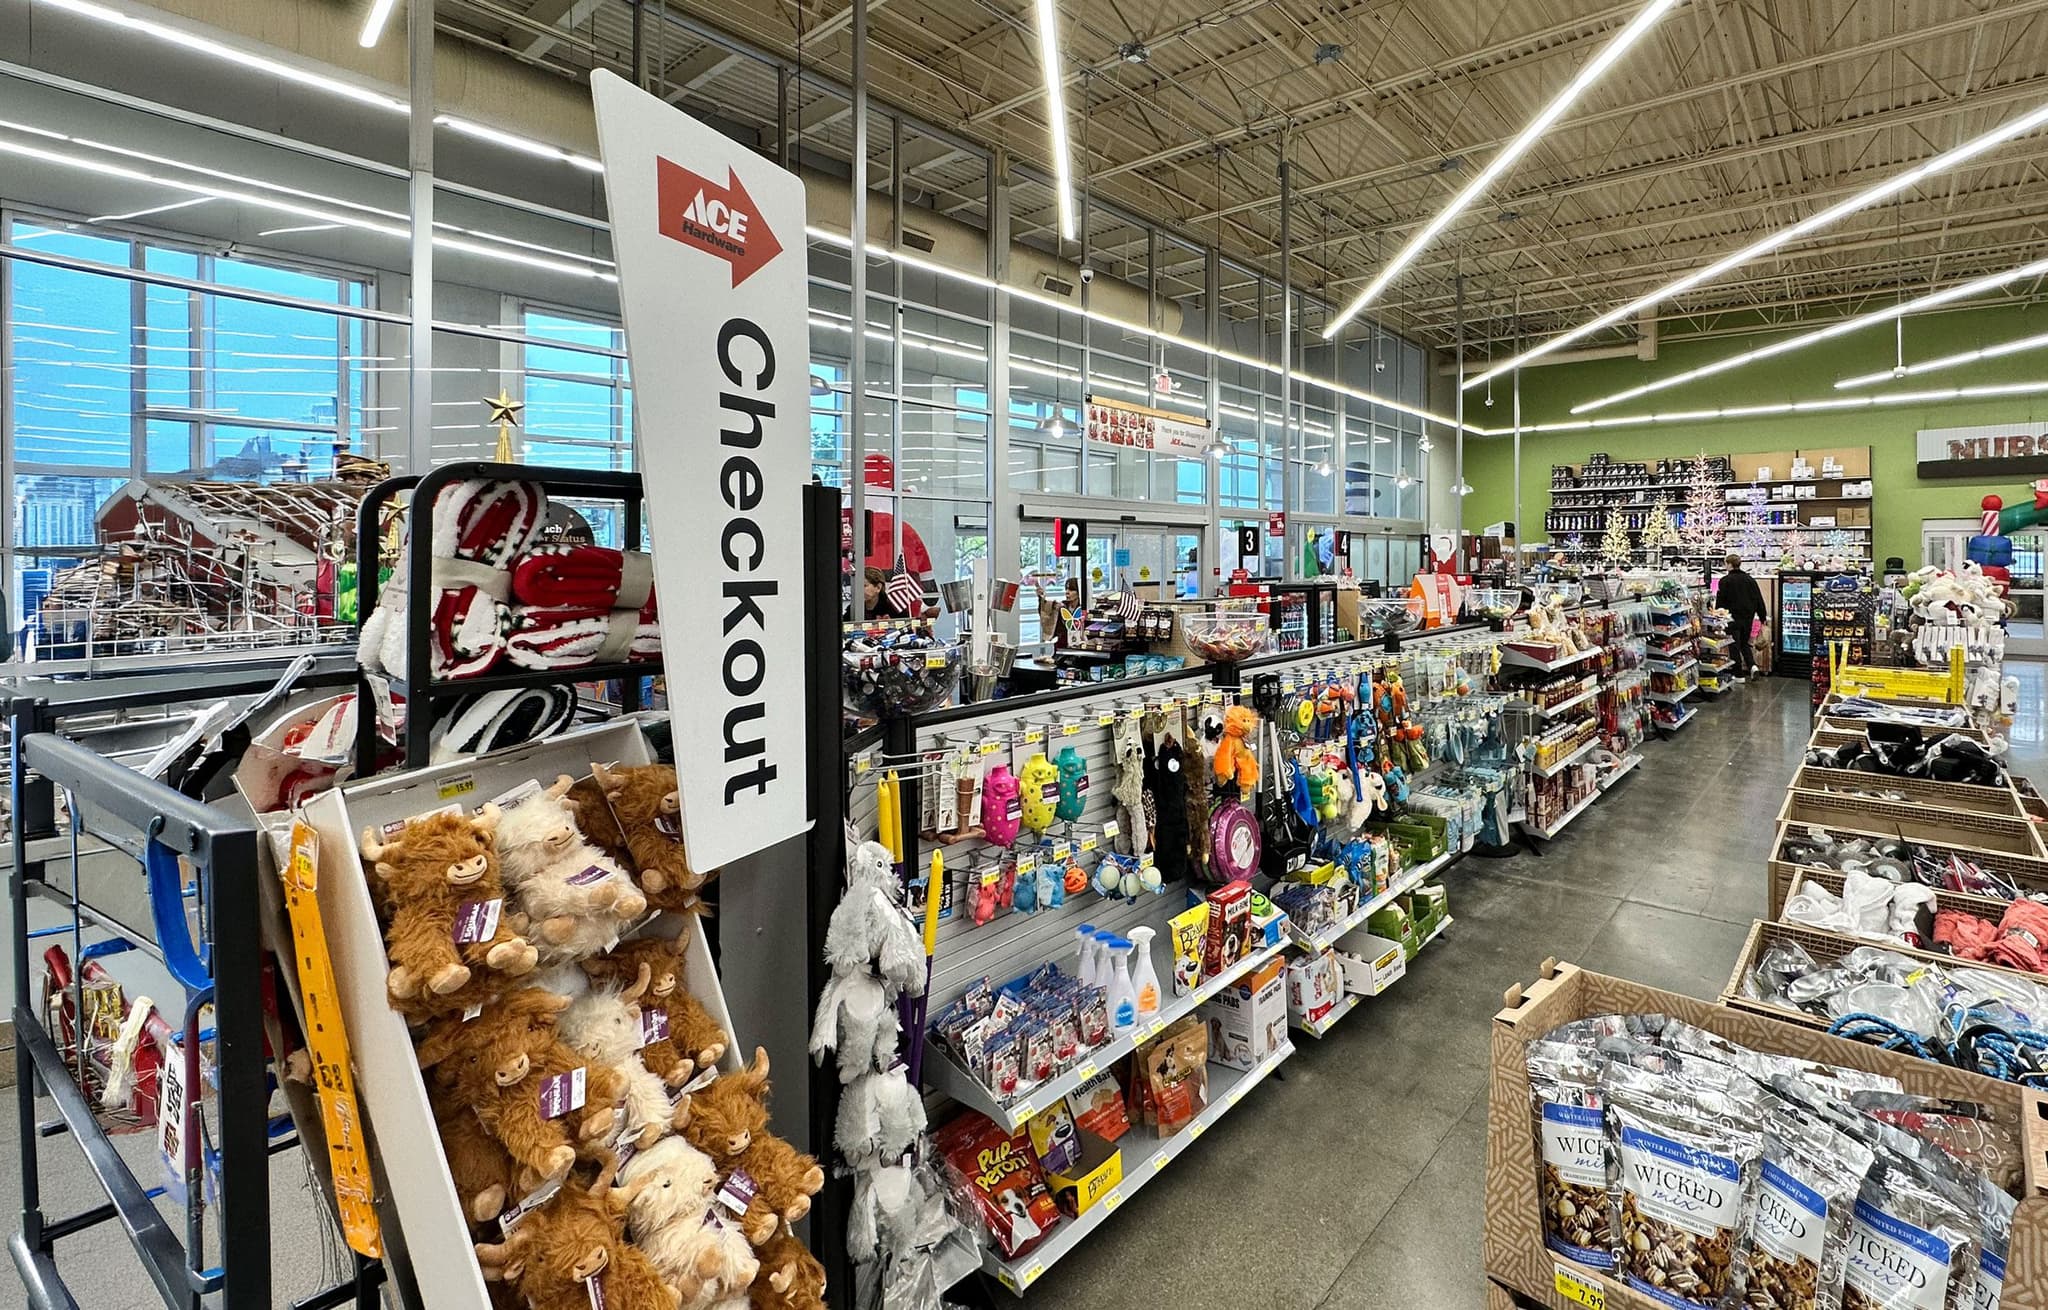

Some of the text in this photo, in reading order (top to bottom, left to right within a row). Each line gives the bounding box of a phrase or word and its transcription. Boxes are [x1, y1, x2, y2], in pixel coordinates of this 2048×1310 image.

[683, 188, 748, 243] ACE
[682, 220, 745, 257] Hardware
[1066, 524, 1079, 551] 2
[1245, 530, 1254, 552] 3
[1340, 534, 1348, 553] 4
[1475, 538, 1481, 553] 6
[717, 317, 779, 807] Checkout
[456, 781, 474, 793] 15.99
[1072, 1077, 1097, 1101] Health
[1635, 1164, 1723, 1209] WICKED
[1764, 1169, 1786, 1188] LIMITED
[1652, 1189, 1700, 1211] mix
[1867, 1212, 1897, 1233] LIMITED
[1898, 1229, 1930, 1249] EDITION
[1849, 1255, 1900, 1286] mix
[1578, 1288, 1604, 1310] 7.99
